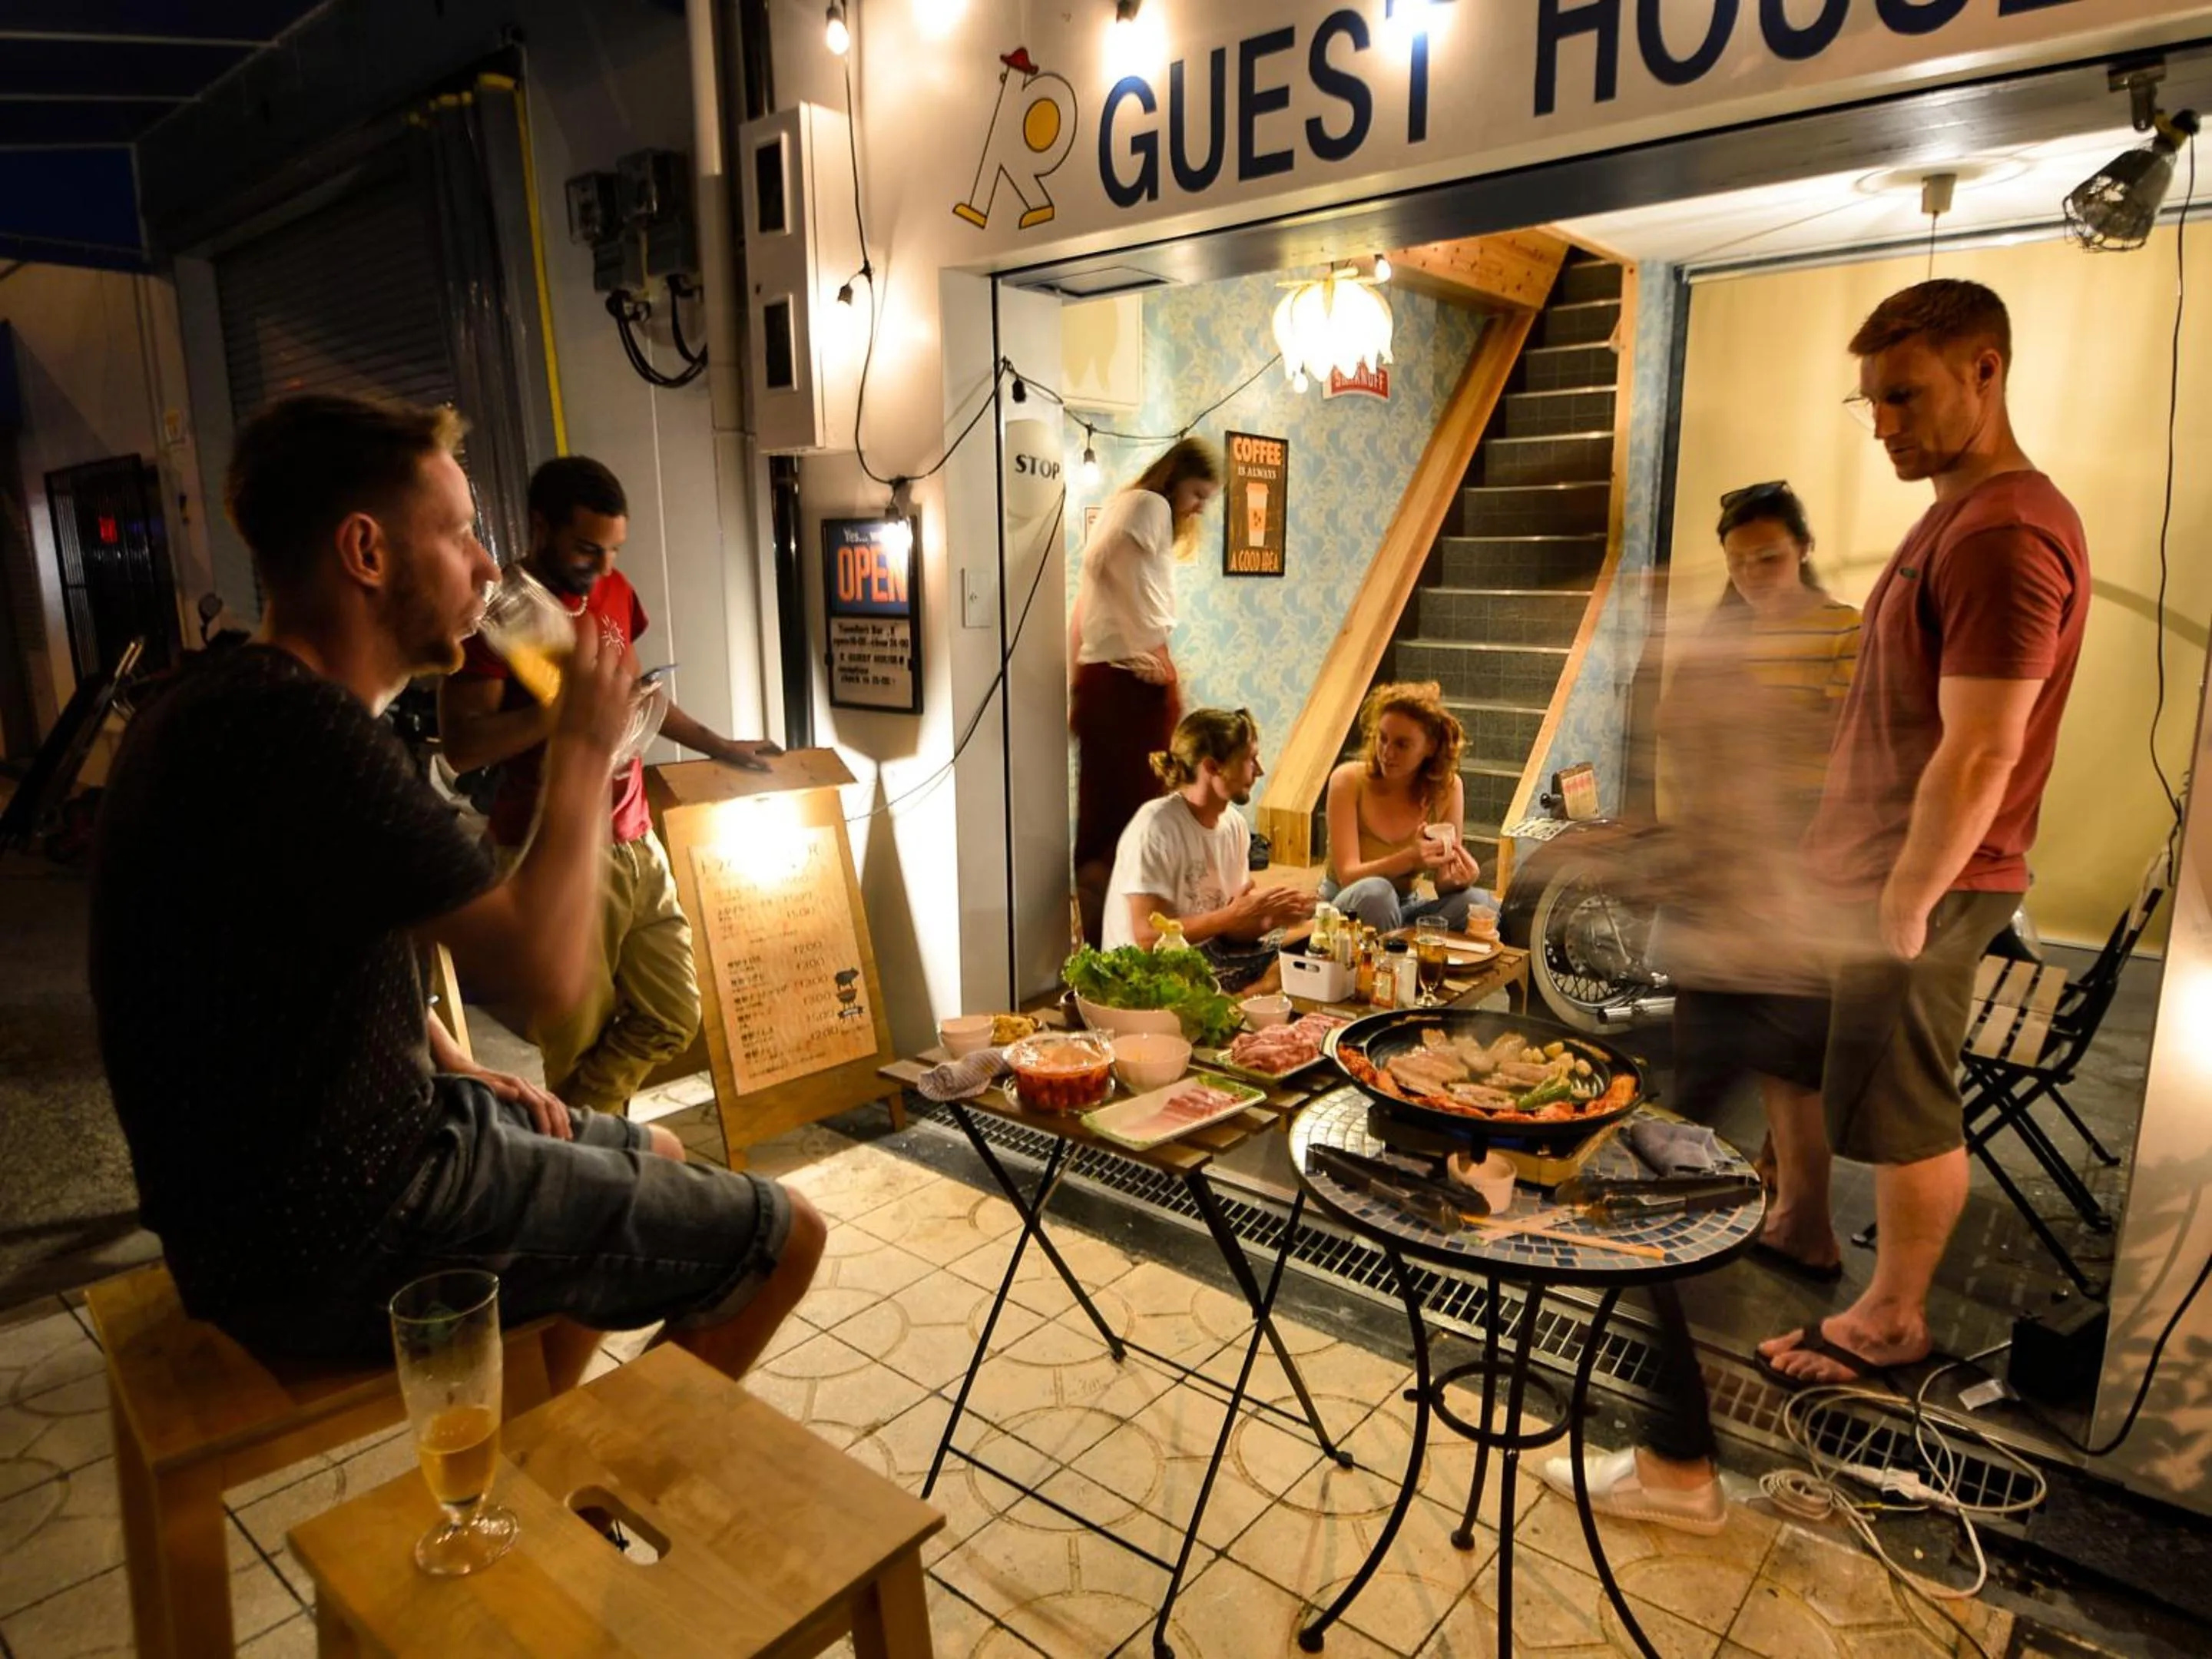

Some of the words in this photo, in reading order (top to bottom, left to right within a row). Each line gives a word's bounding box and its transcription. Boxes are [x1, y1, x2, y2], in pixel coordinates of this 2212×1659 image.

[1098, 0, 1452, 207] GUEST
[1233, 437, 1281, 465] COFFEE
[1015, 453, 1060, 480] STOP
[1238, 466, 1245, 476] IS
[1247, 466, 1276, 479] ALWAYS
[837, 545, 907, 602] OPEN
[1230, 550, 1237, 571] A
[1238, 550, 1260, 572] GOOD
[1261, 549, 1280, 573] IDEA
